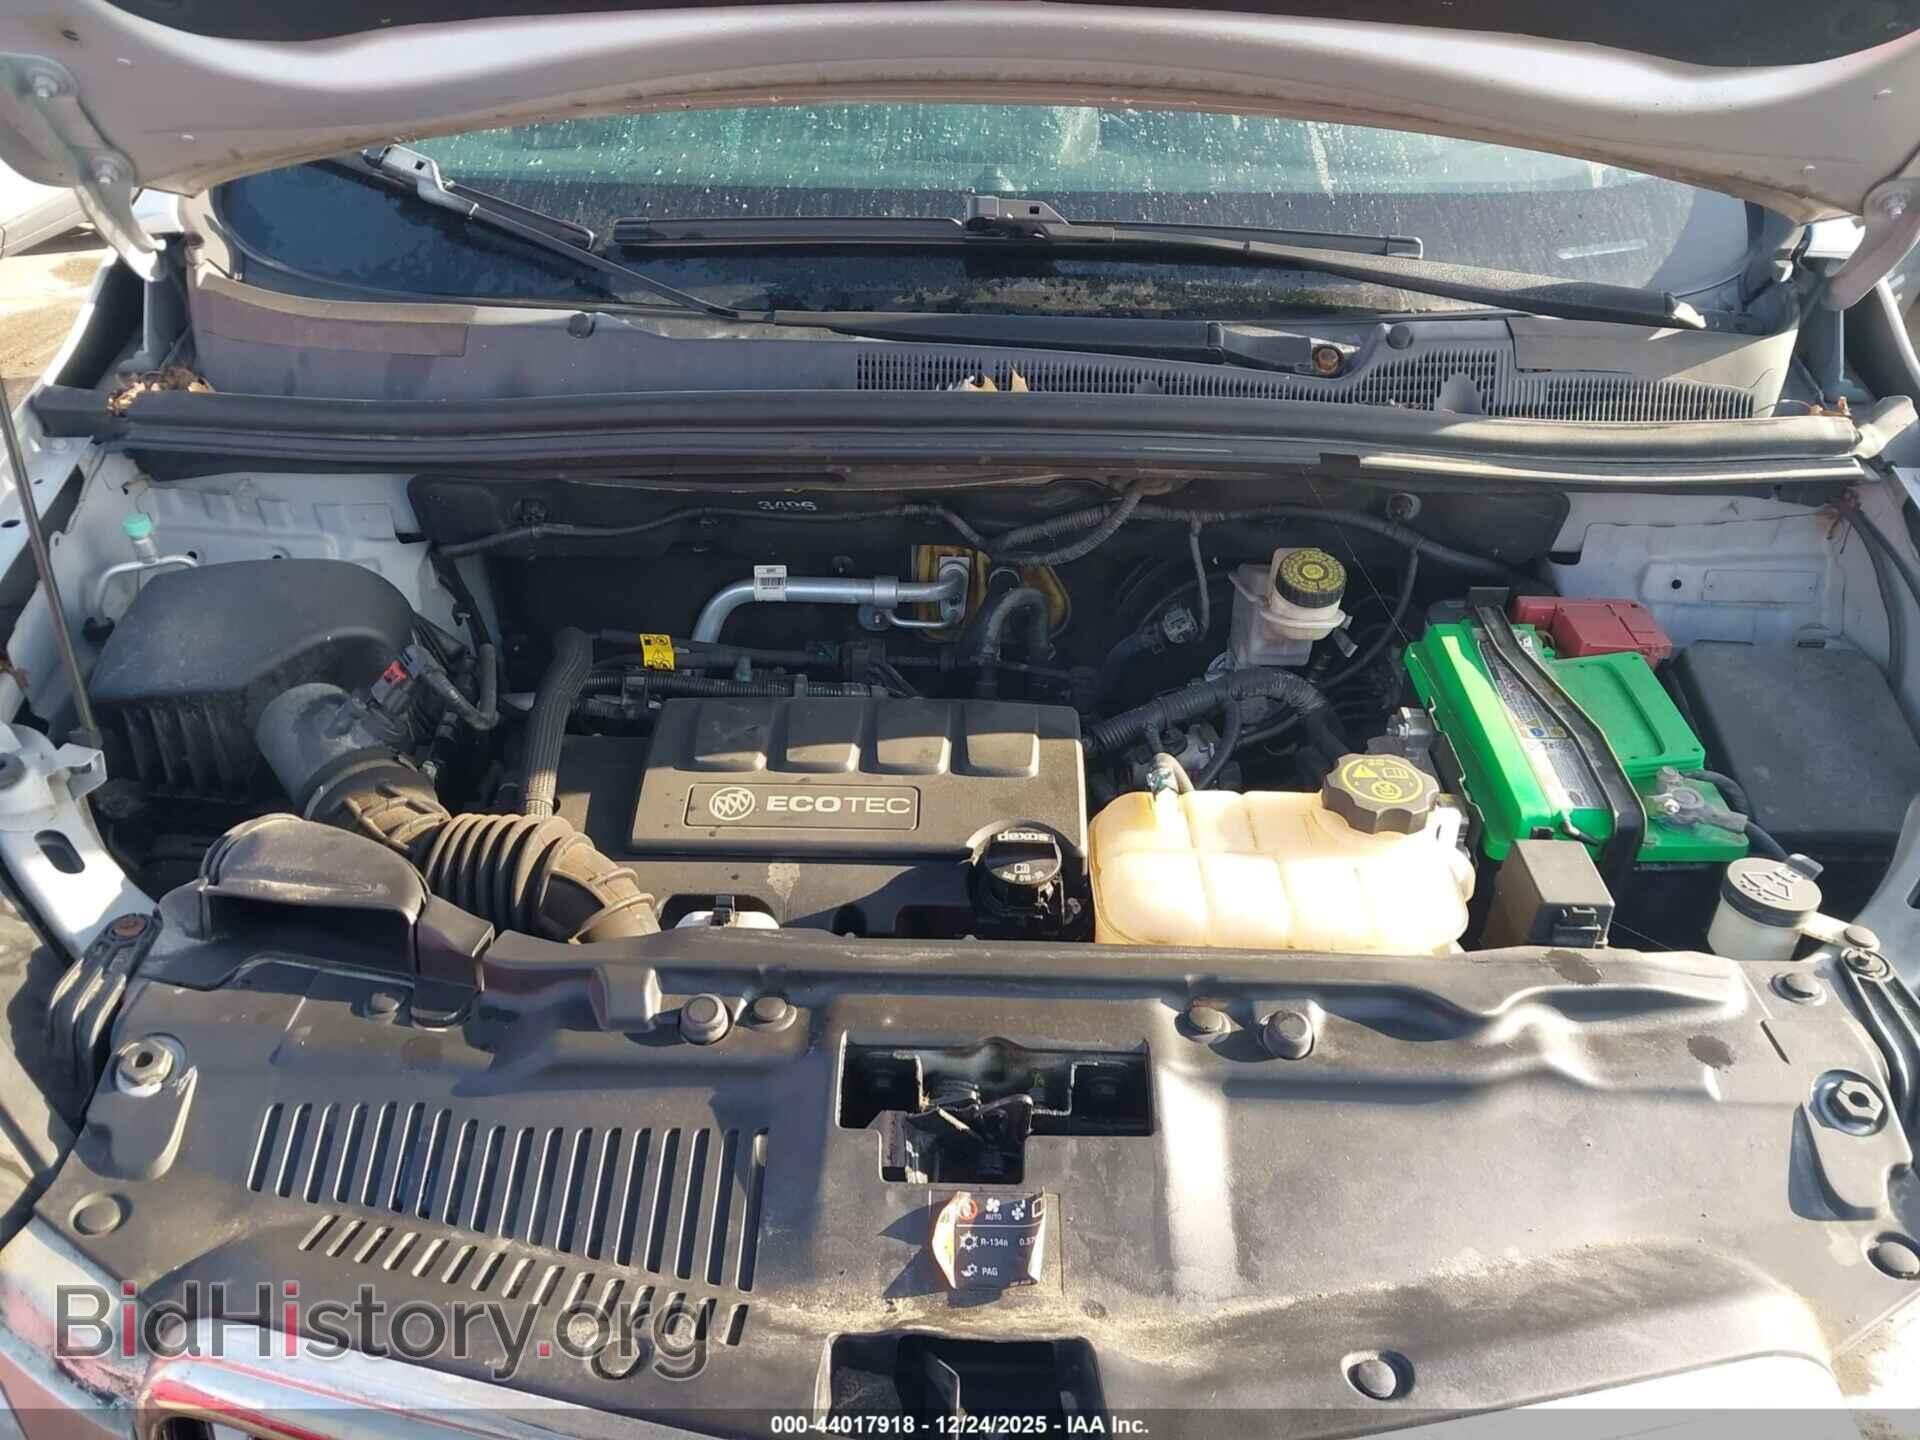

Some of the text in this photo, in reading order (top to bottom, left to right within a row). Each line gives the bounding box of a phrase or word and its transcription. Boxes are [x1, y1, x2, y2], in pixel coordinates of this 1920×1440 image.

[766, 795, 911, 814] ECOTEC
[985, 1213, 1002, 1221] AUTO
[982, 1266, 998, 1276] PAG
